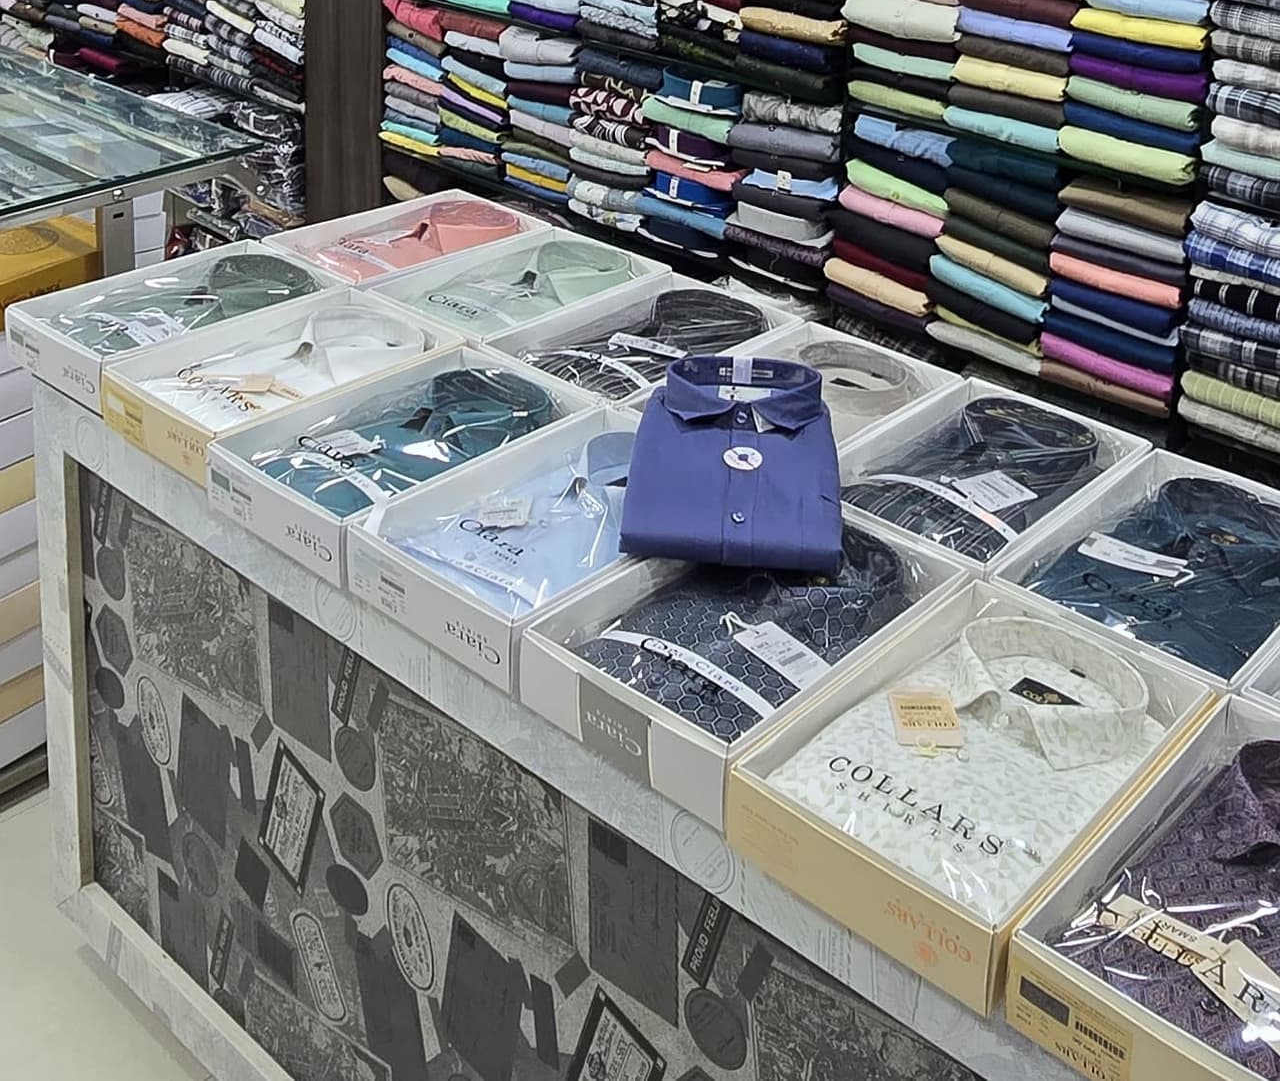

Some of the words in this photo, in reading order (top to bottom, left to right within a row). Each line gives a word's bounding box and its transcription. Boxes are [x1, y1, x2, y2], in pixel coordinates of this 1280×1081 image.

[427, 293, 478, 317] Ciara
[286, 524, 333, 563] Ciara
[459, 519, 525, 557] Ciara
[444, 621, 501, 665] Ciara
[584, 709, 642, 757] Ciara
[836, 781, 966, 854] SHIRTS
[689, 933, 709, 974] PROUD
